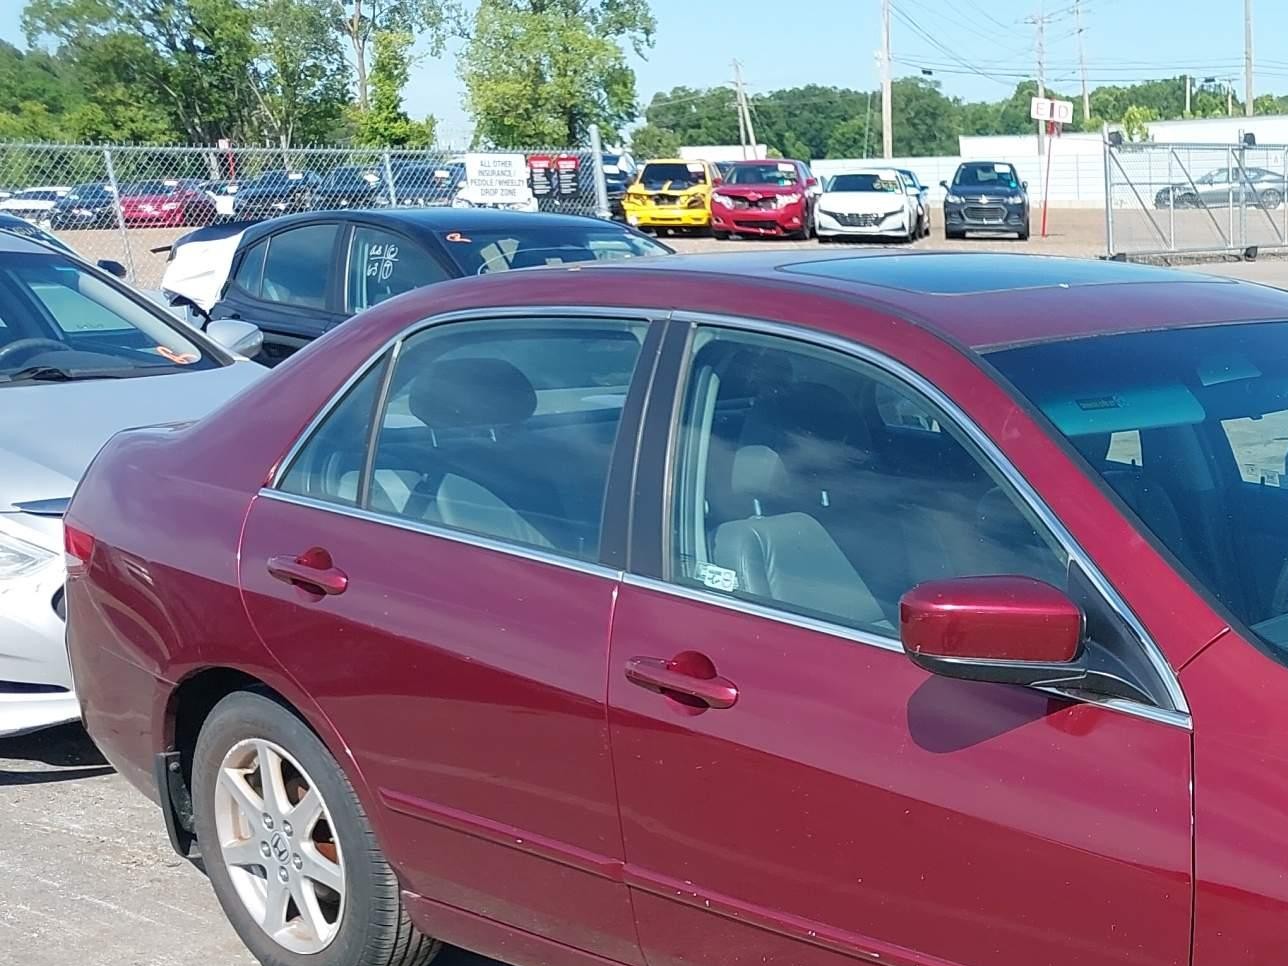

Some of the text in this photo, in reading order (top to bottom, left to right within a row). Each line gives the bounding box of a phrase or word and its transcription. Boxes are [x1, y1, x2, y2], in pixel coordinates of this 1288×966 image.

[480, 160, 513, 168] ALL OTHER
[480, 188, 517, 197] DROP ZONE
